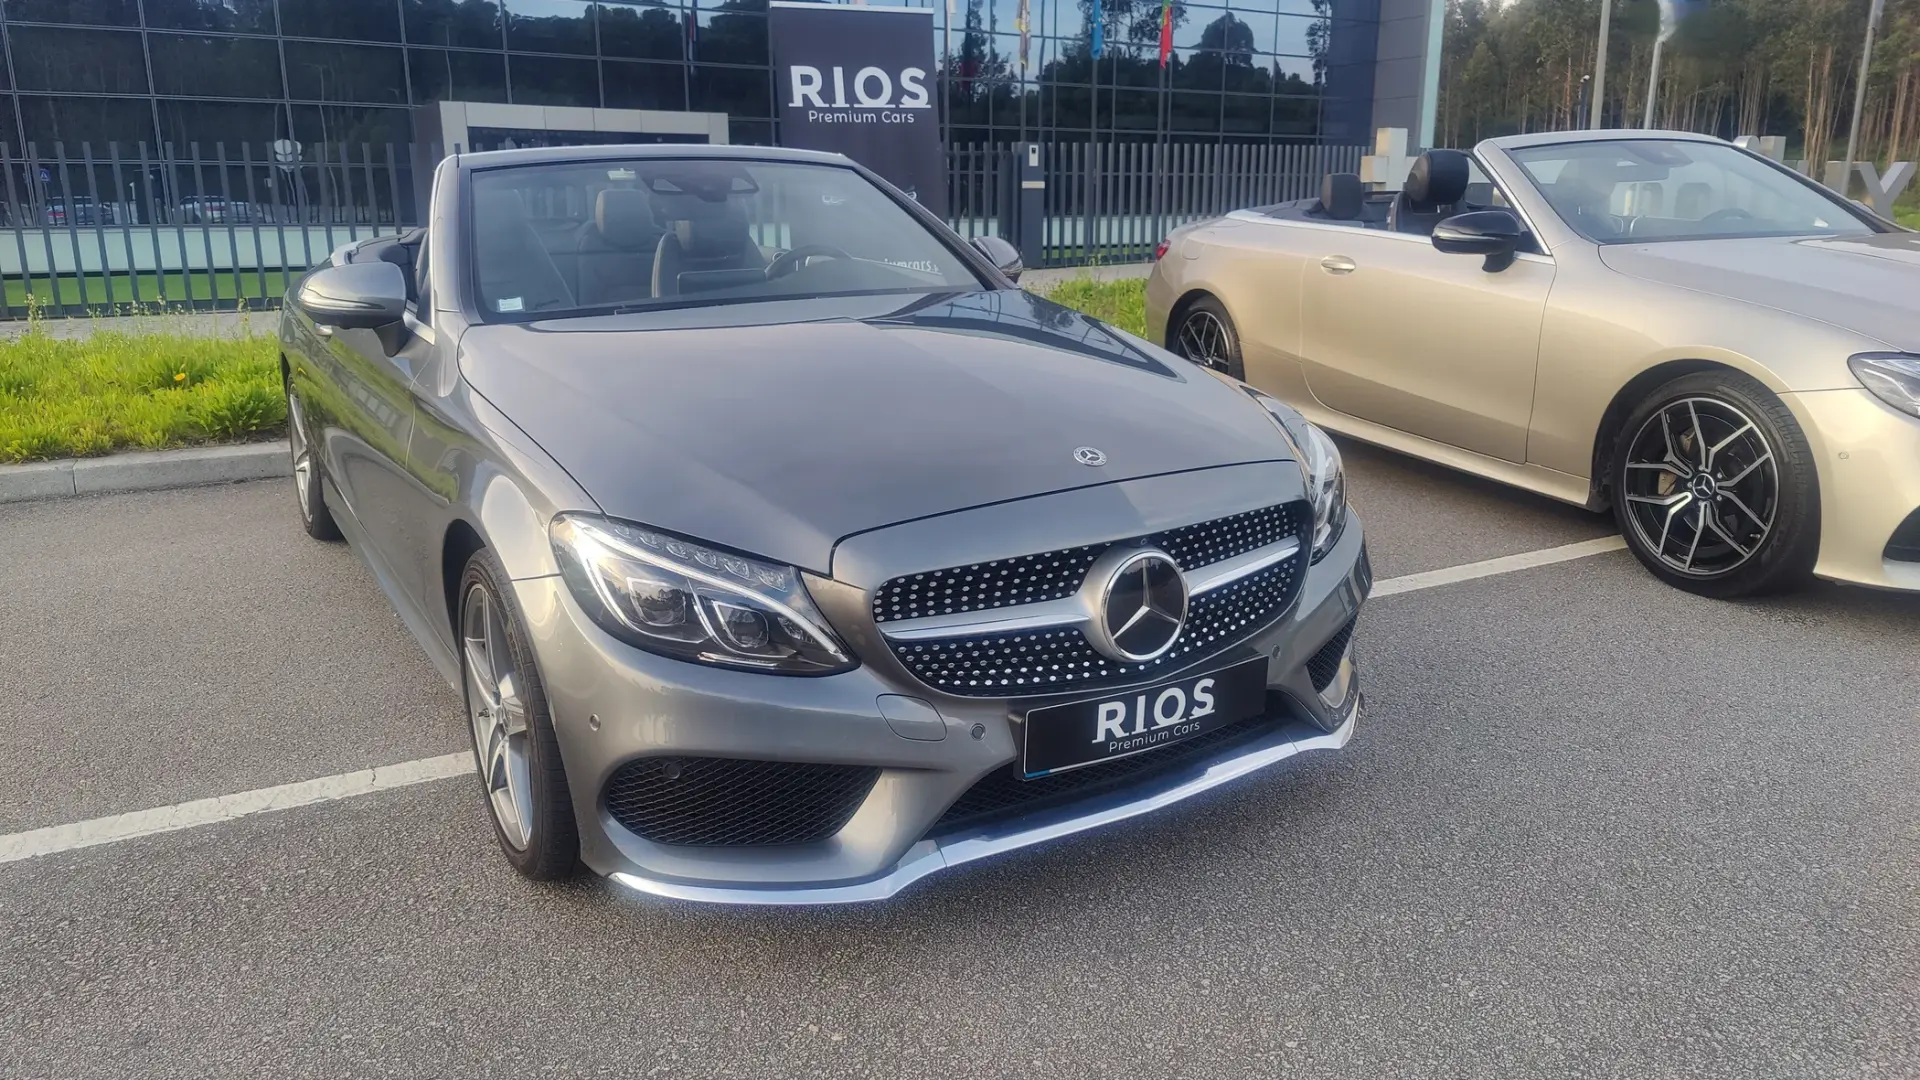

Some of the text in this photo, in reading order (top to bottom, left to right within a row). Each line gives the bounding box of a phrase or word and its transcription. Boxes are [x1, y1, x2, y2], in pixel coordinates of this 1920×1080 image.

[788, 65, 932, 108] RIOS
[808, 110, 915, 123] Premium Cars
[1092, 678, 1216, 744] RIOS
[1109, 720, 1200, 753] Premium Cars
